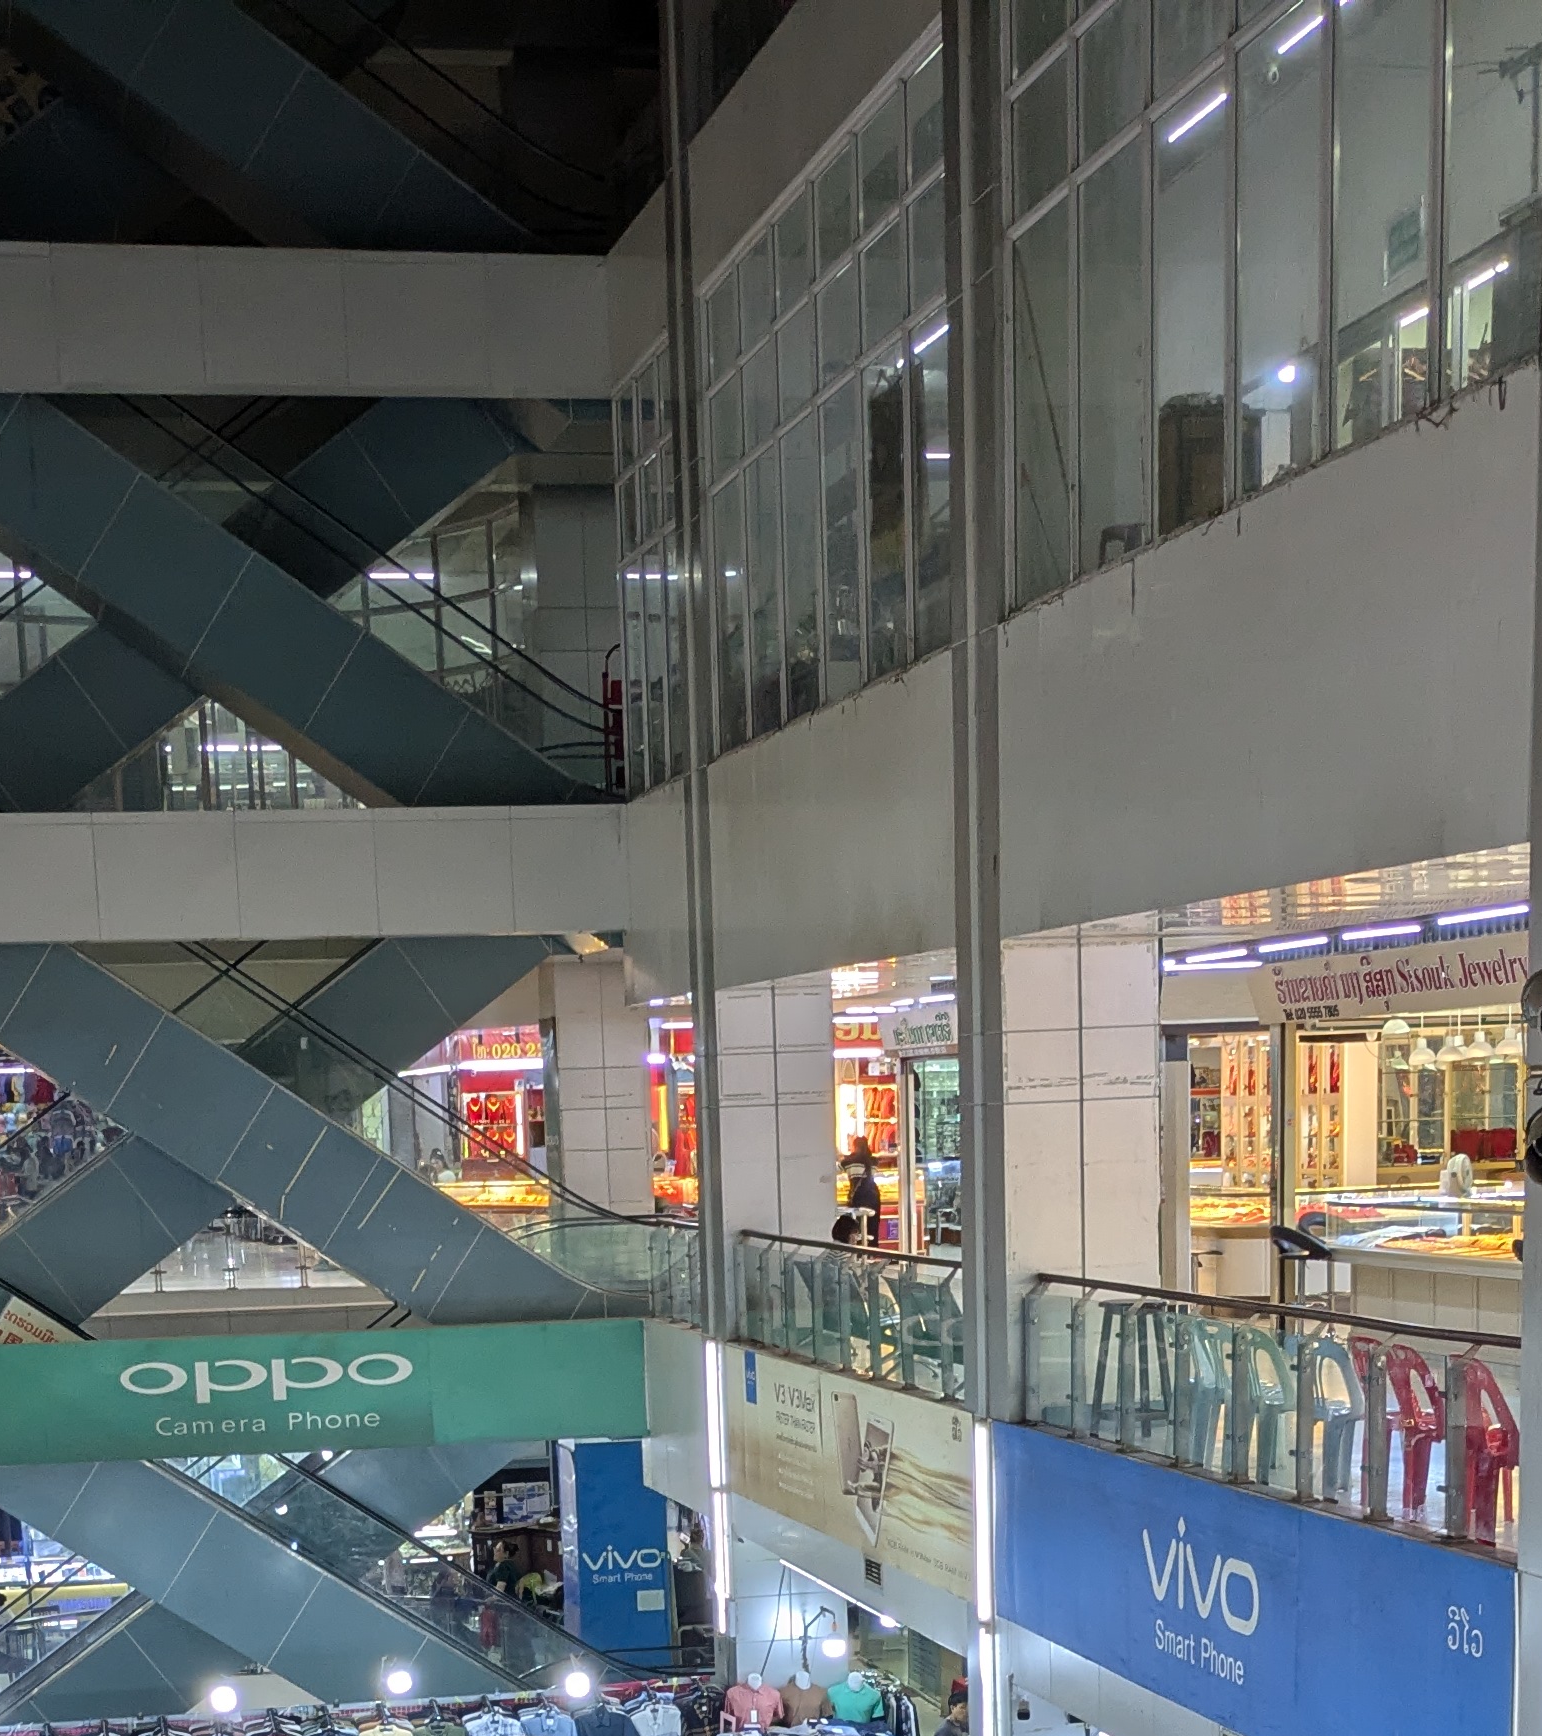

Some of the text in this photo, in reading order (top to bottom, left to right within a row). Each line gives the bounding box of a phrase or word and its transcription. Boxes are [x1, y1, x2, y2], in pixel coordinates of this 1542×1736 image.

[1396, 954, 1455, 995] Sisouk
[1457, 948, 1528, 989] Jewelry
[119, 1353, 414, 1404] oppo
[155, 1410, 381, 1436] Camera Phone
[582, 1544, 662, 1571] vivo
[592, 1572, 653, 1585] Smart Phone
[1142, 1516, 1259, 1636] vivo
[1155, 1618, 1244, 1686] Smart Phone
